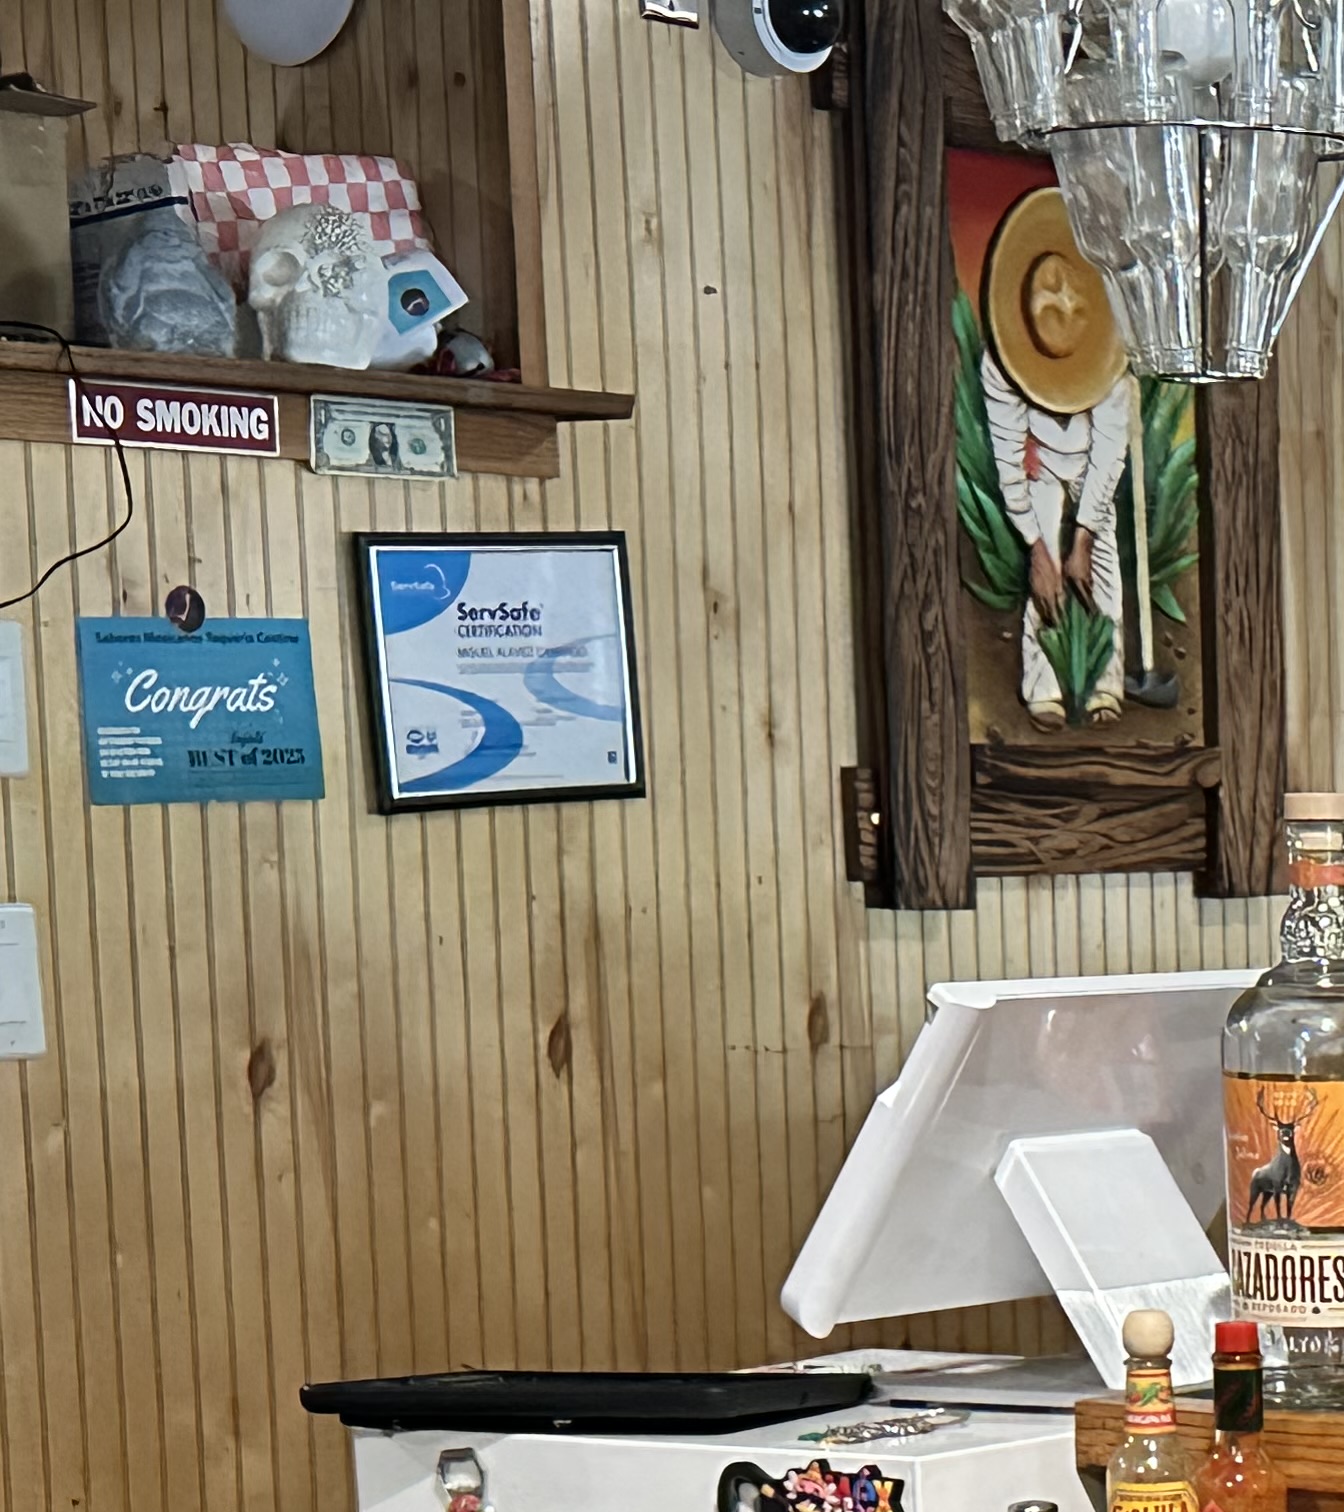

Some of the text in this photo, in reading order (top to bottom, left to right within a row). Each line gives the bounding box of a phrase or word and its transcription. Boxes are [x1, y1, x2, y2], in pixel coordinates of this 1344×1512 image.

[82, 395, 270, 441] NO SMOKING
[456, 602, 542, 622] ServSafe
[456, 624, 543, 638] CERTIFICATION
[125, 668, 278, 729] Congrats
